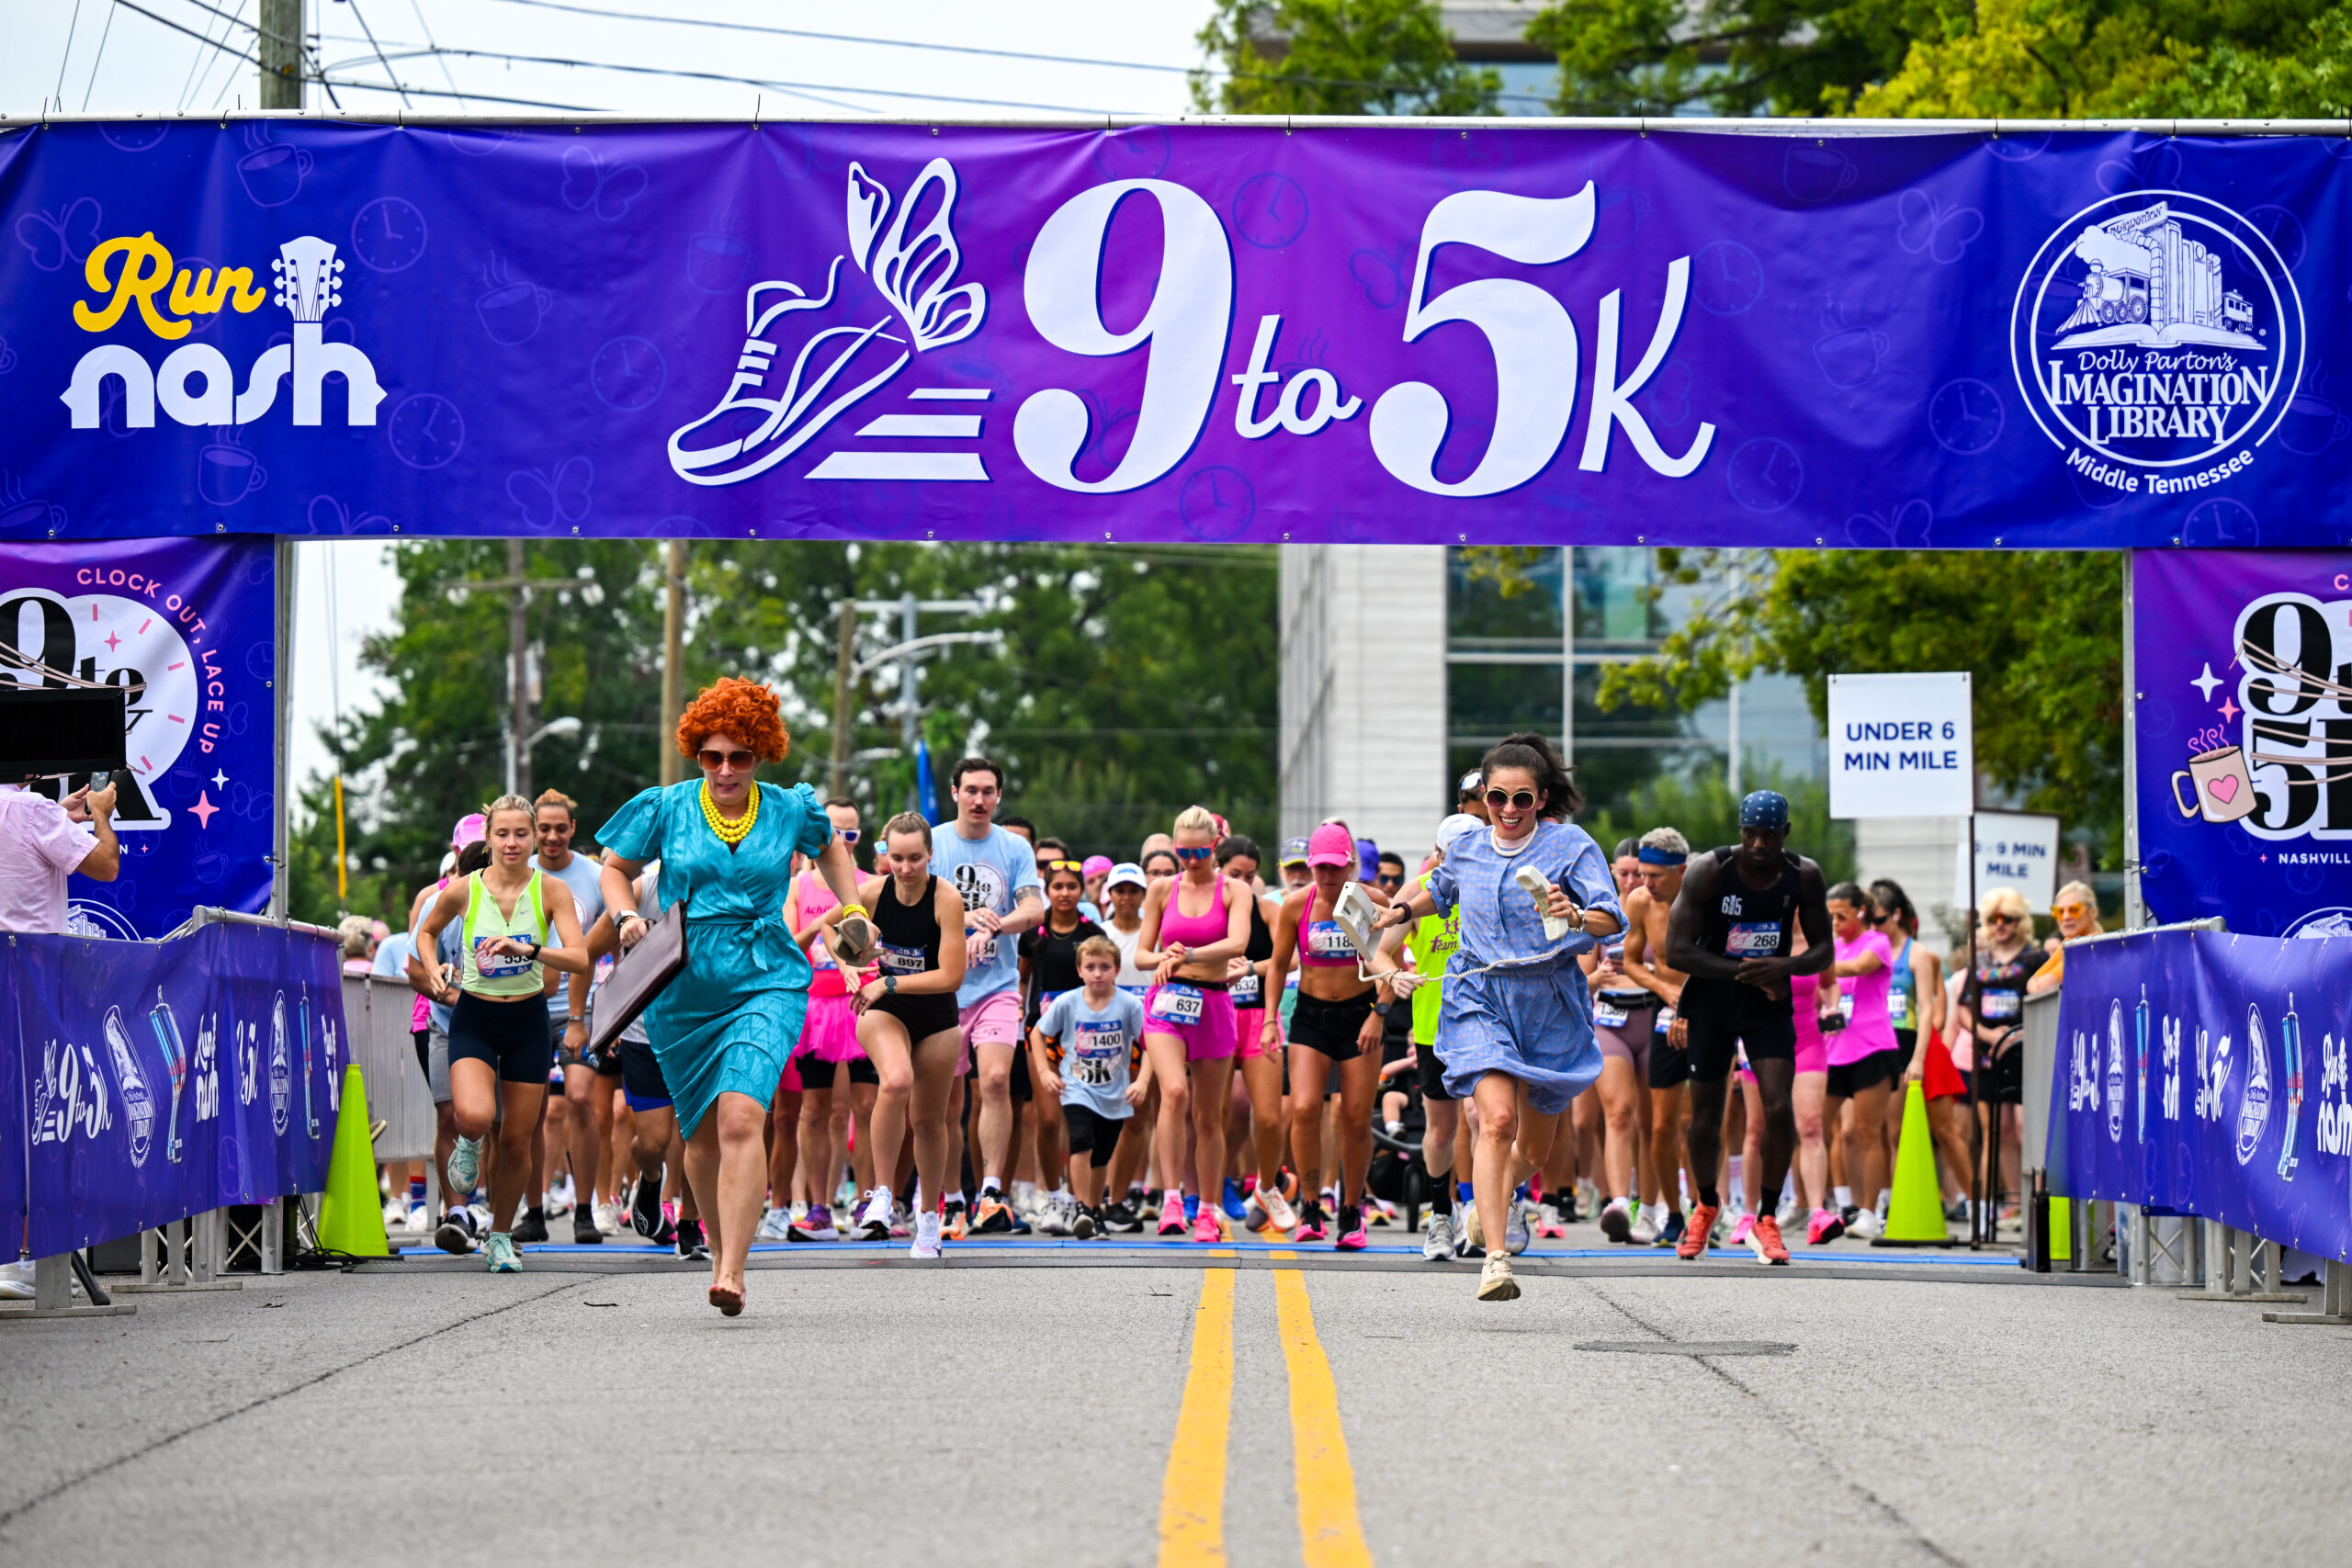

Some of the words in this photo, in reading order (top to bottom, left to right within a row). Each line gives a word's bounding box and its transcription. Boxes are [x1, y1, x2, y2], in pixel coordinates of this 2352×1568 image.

[74, 231, 266, 340] Run
[1013, 178, 1233, 493] 9
[1232, 314, 1363, 439] to
[60, 322, 387, 429] nash
[2078, 349, 2139, 374] Dolly
[2145, 351, 2237, 371] Parton's
[2049, 360, 2267, 404] IMAGINATION
[2087, 406, 2232, 445] LIBRARY
[2066, 447, 2139, 492] Middle
[2144, 449, 2254, 494] Tennessee
[77, 568, 162, 599] CLOCK
[165, 594, 207, 645] OUT,
[2244, 602, 2332, 716] 9
[201, 649, 225, 713] LACE
[198, 722, 220, 753] UP
[1847, 722, 1932, 741] UNDER
[1941, 721, 1955, 739] 6
[1844, 752, 1890, 770] MIN
[1899, 751, 1958, 770] MILE
[2013, 841, 2045, 856] MIN
[2278, 853, 2351, 865] NASHVILL
[956, 864, 976, 891] 9
[1986, 863, 2029, 877] MILE
[1328, 936, 1354, 947] 118
[1753, 935, 1778, 947] 268
[898, 957, 923, 968] 897
[1176, 998, 1201, 1014] 637
[1092, 1033, 1121, 1046] 1400
[57, 1043, 79, 1143] 9
